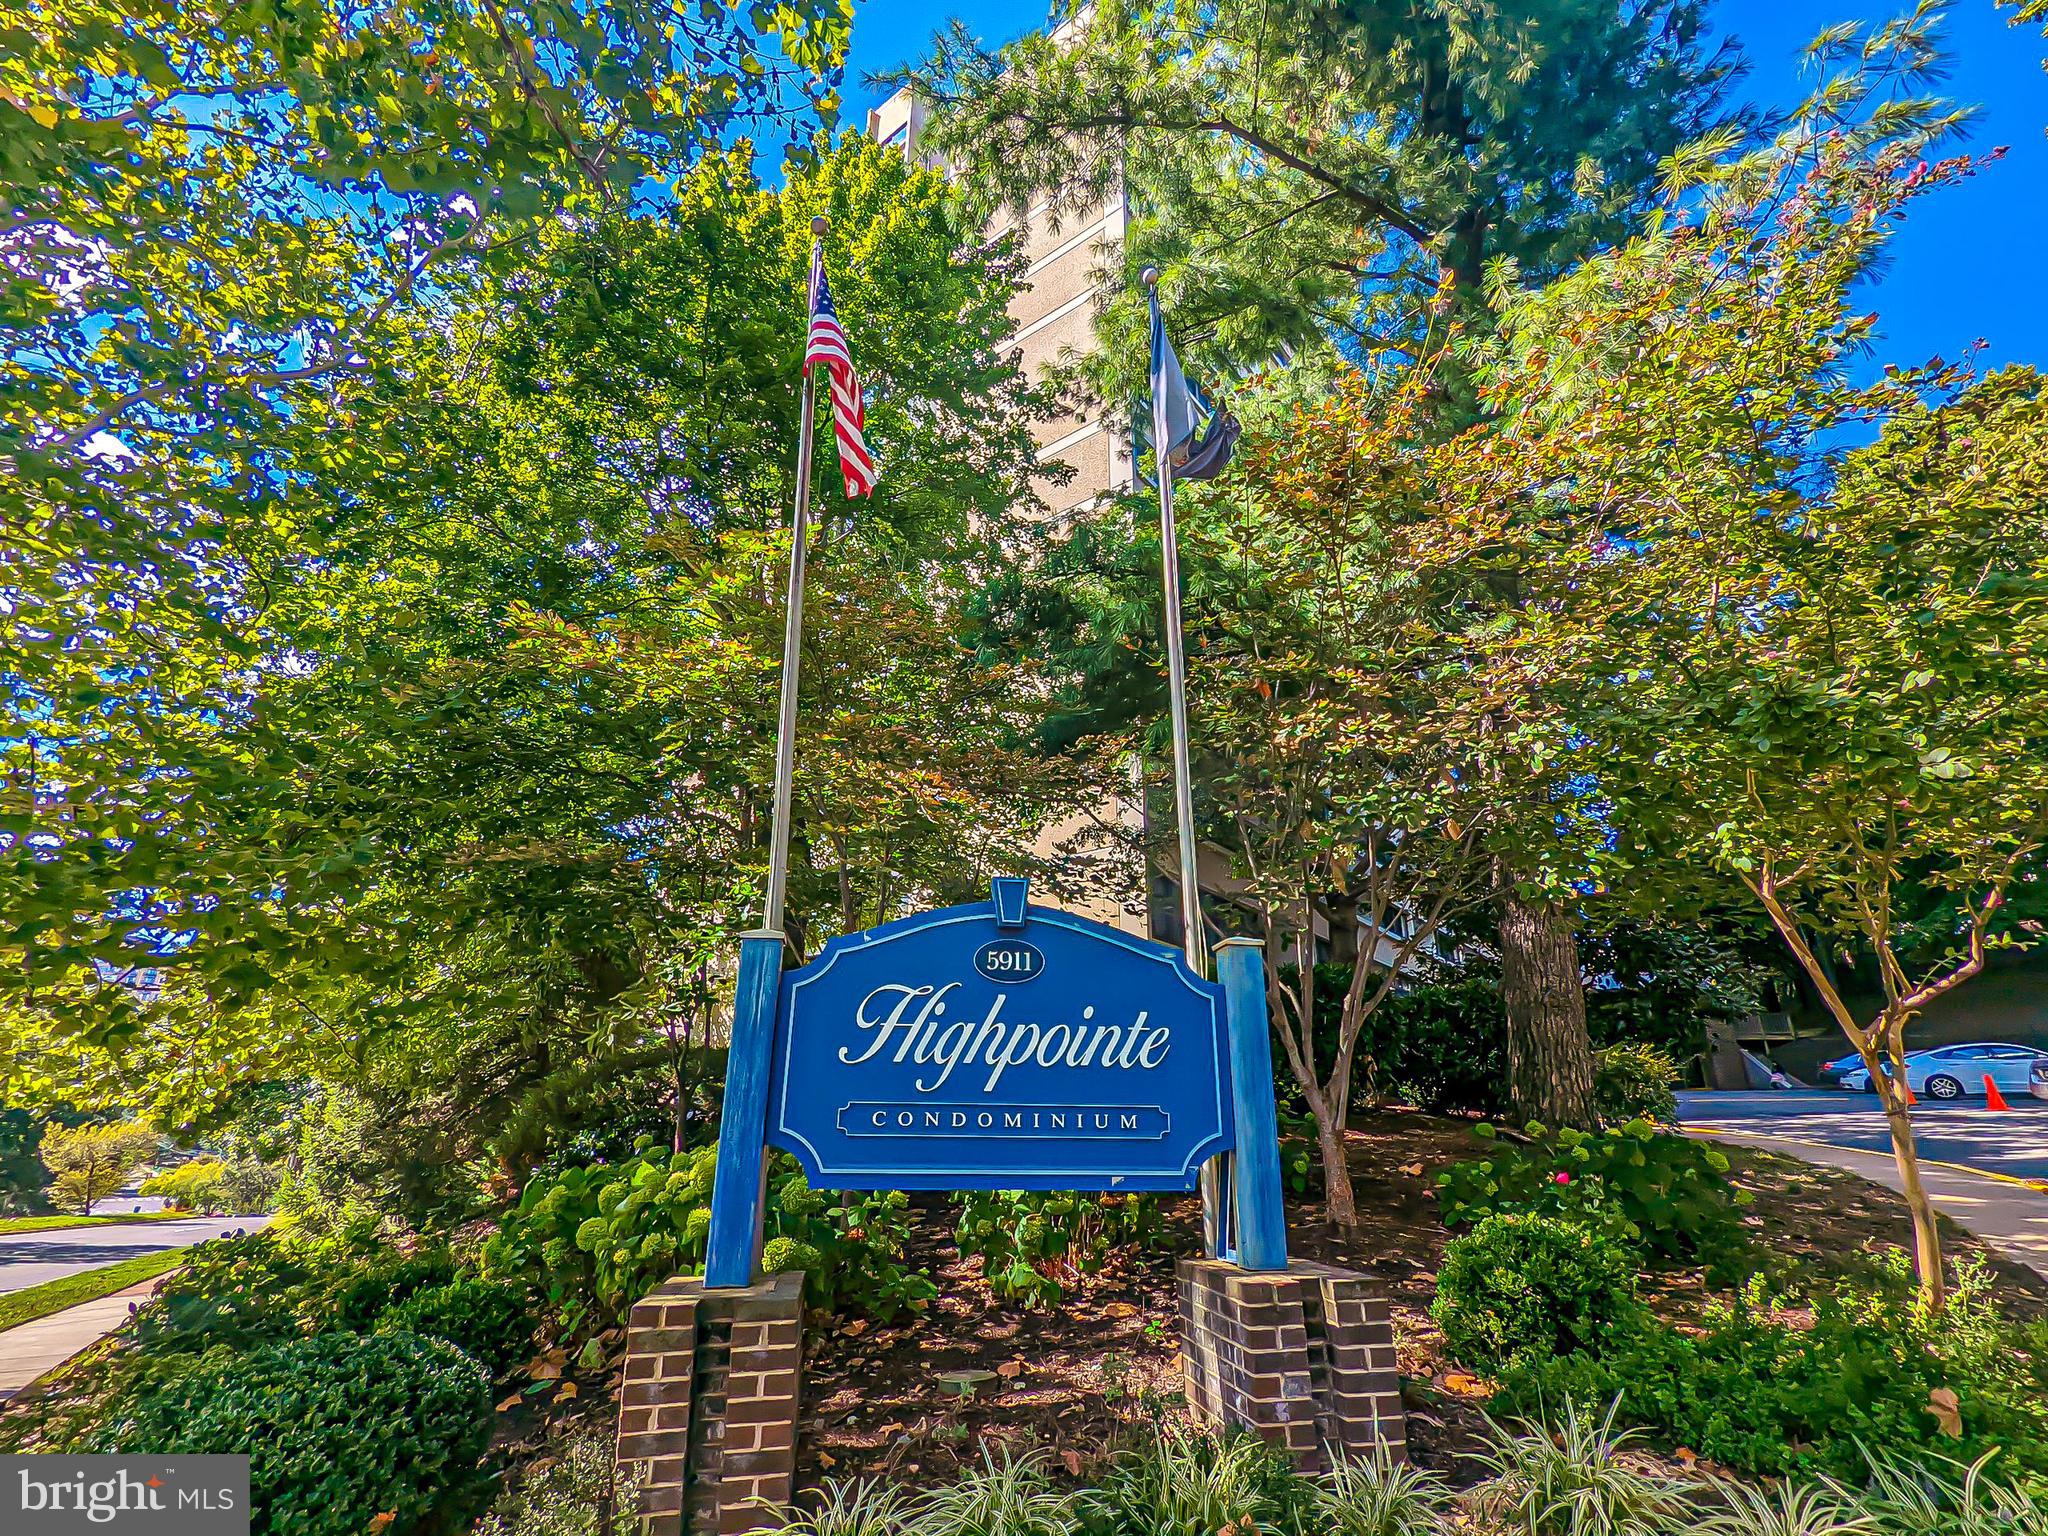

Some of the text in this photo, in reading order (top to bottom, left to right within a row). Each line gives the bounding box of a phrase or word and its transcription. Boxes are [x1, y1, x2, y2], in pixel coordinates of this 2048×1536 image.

[986, 949, 1033, 972] 5911
[838, 982, 1171, 1093] Highpointe
[872, 1110, 1139, 1130] CONDOMINIUM
